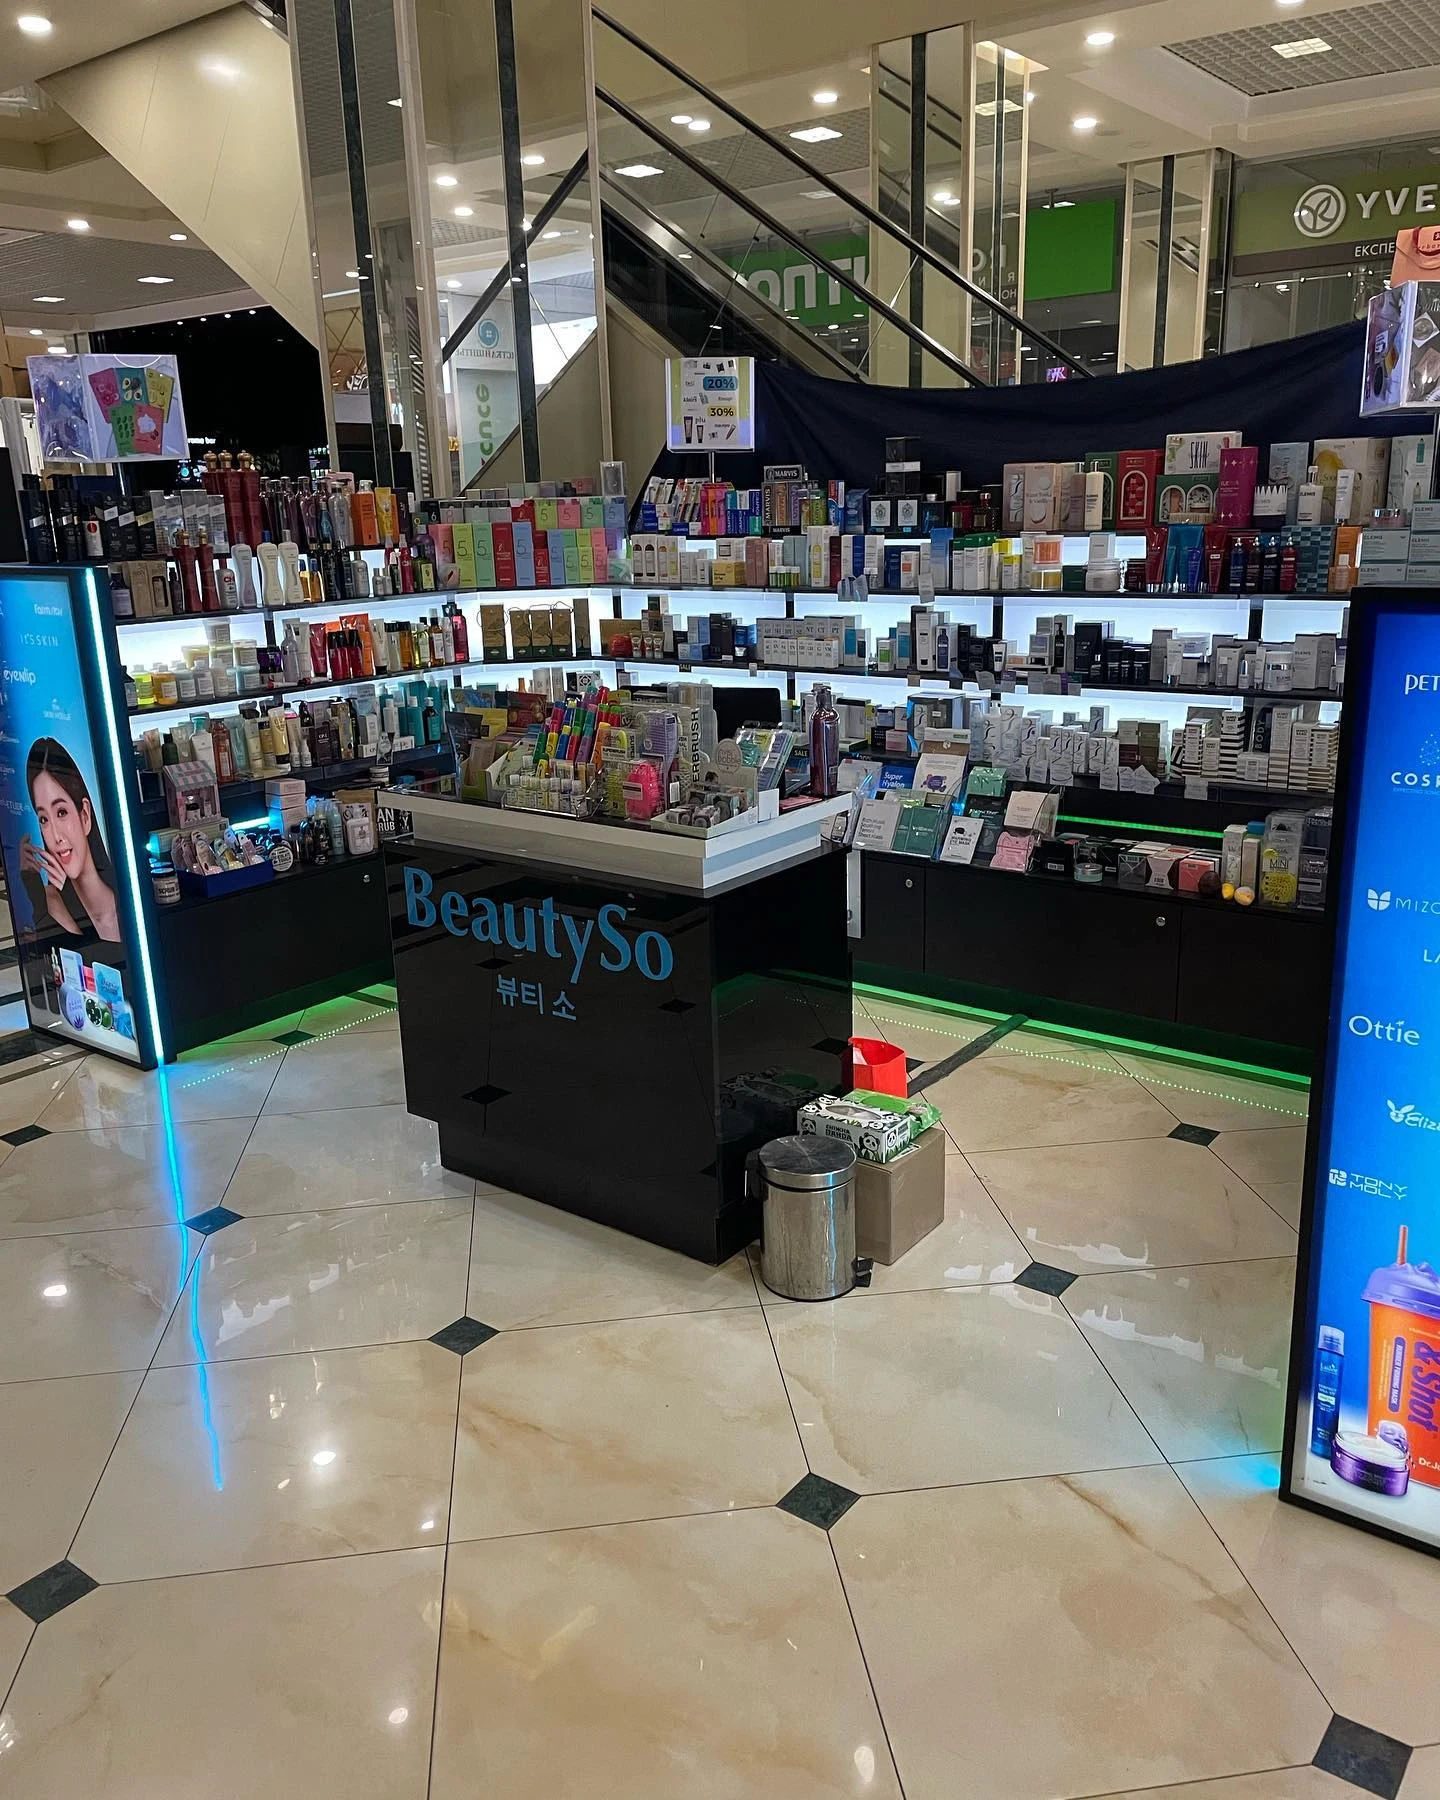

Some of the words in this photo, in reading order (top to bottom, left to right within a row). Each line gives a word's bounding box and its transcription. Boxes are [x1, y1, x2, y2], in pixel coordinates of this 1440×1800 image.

[1356, 184, 1438, 219] YVE
[708, 379, 734, 389] 20%
[710, 407, 734, 417] 30%
[1188, 441, 1209, 469] SKIN
[775, 469, 798, 477] MARVIS
[457, 541, 467, 557] 5
[476, 541, 487, 556] 5
[1255, 720, 1265, 749] BODY
[881, 780, 905, 788] Hyalon
[884, 772, 904, 780] Super
[403, 866, 674, 981] BeautySo
[1348, 1015, 1420, 1046] Ottie
[1349, 1181, 1407, 1200] MOLY
[1350, 1173, 1408, 1193] TONY
[1391, 1388, 1400, 1405] MASK
[1408, 1365, 1440, 1433] Shot
